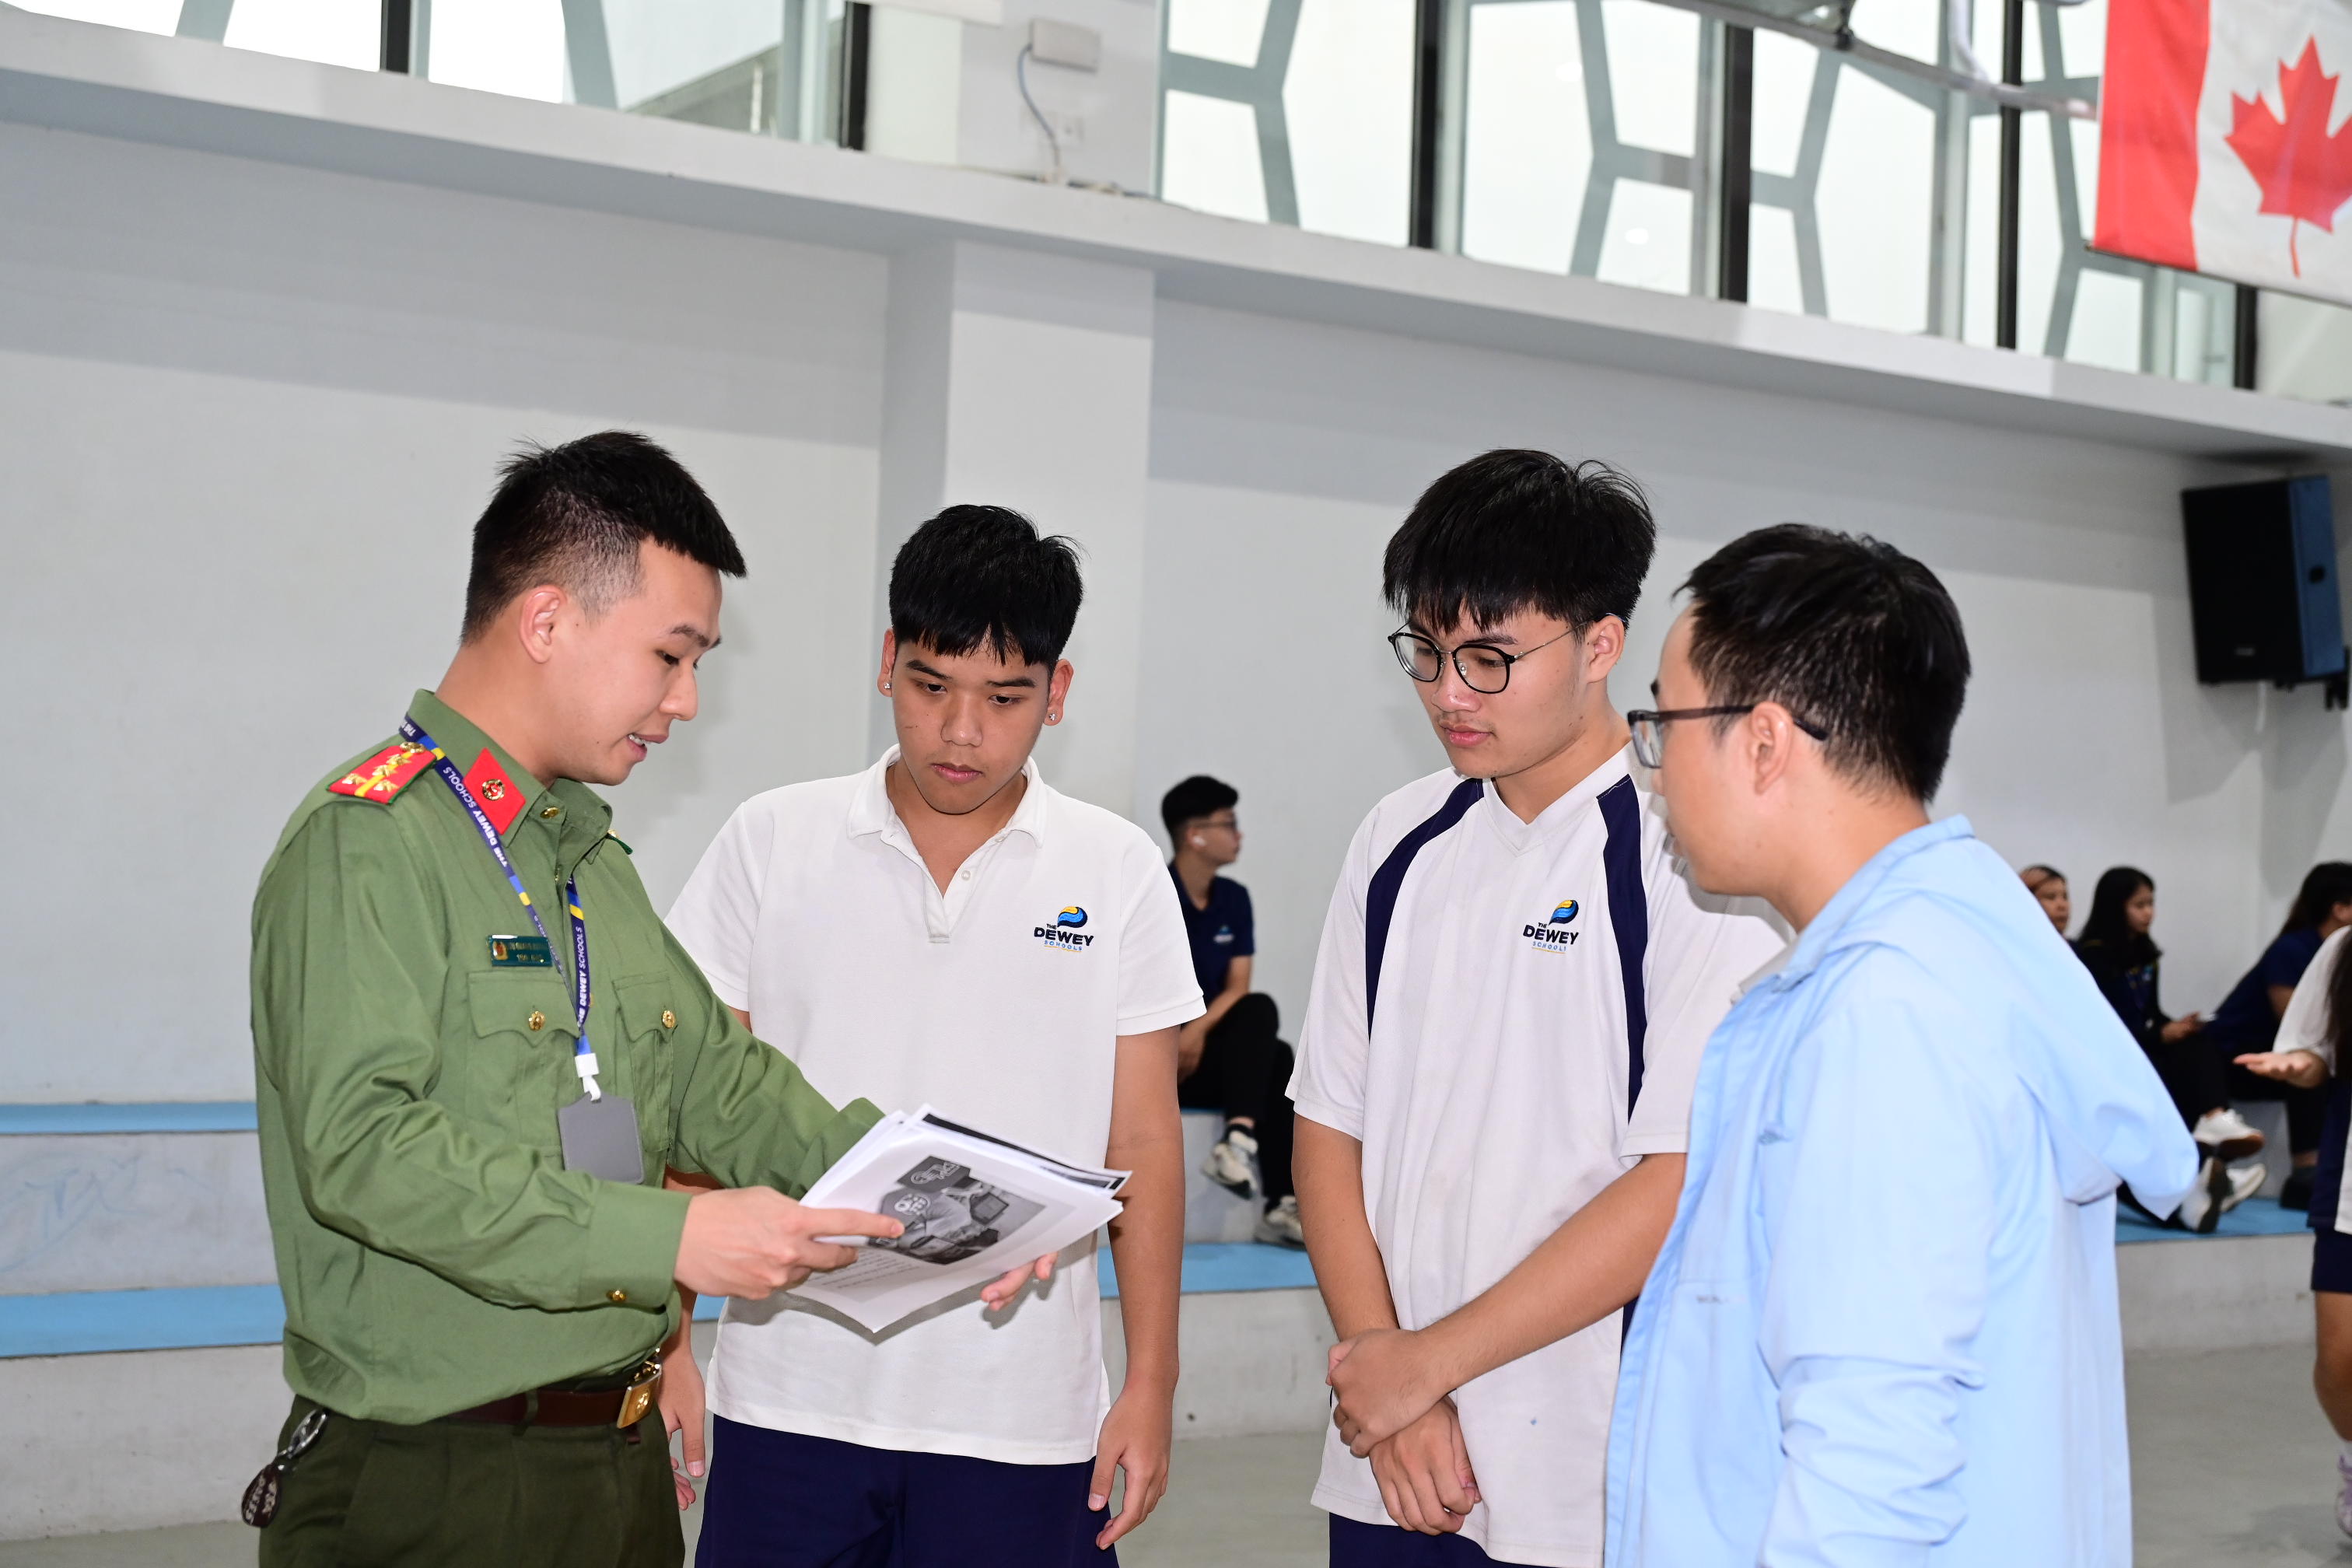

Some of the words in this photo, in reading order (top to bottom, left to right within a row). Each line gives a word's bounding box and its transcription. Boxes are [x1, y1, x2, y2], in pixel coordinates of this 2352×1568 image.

[443, 766, 477, 808] SCHOOLS
[473, 810, 498, 845] DEWEY
[494, 847, 508, 867] THE
[576, 926, 586, 969] SCHOOLS
[1034, 926, 1094, 947] DEWEY
[1522, 925, 1580, 945] DEWEY
[579, 971, 587, 1006] DEWEY
